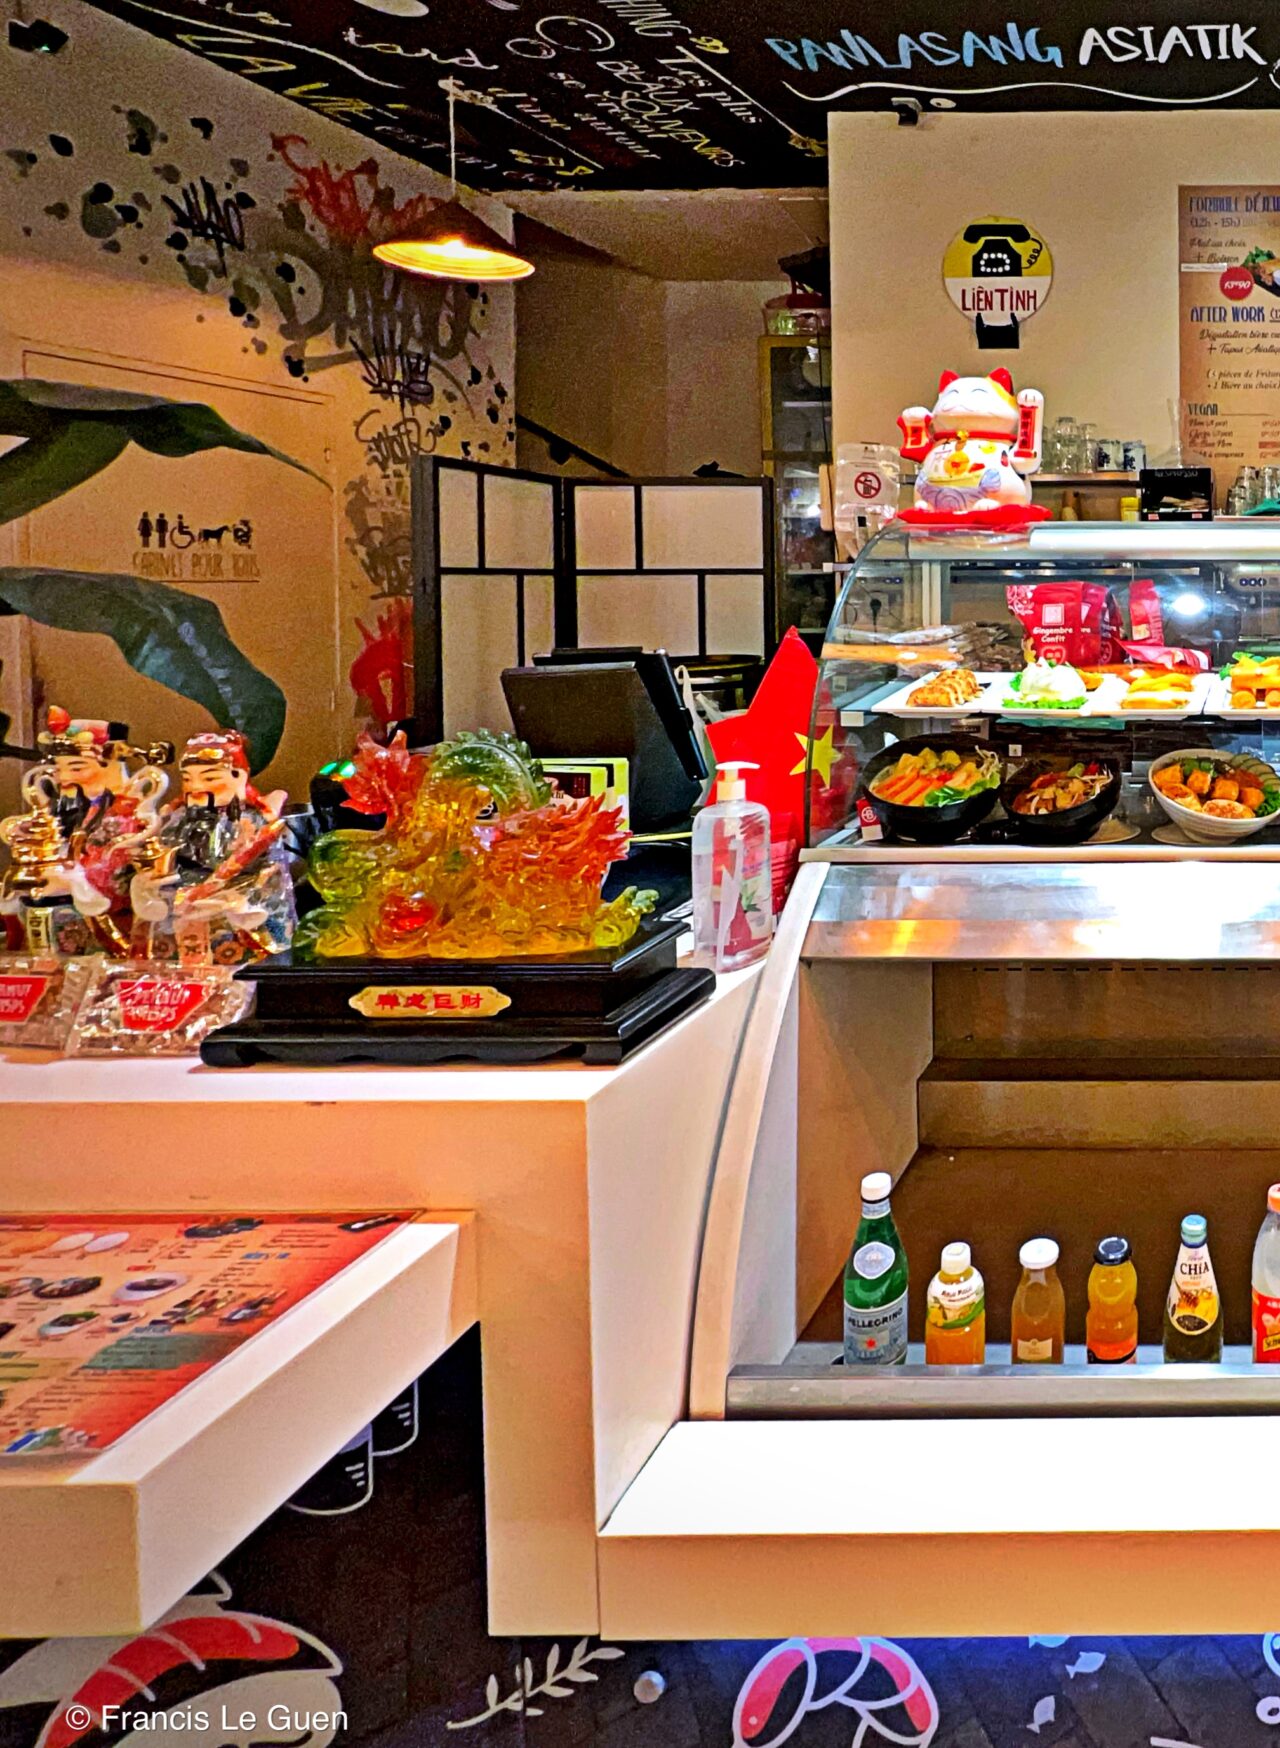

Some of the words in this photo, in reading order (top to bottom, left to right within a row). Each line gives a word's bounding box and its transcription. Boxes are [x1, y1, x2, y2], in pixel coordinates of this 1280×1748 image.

[765, 22, 1064, 72] PANLASANG
[1079, 24, 1268, 66] ASIATIK
[1190, 305, 1227, 322] AFTER
[1231, 306, 1266, 322] WORK
[1188, 403, 1218, 416] VEGAN
[1032, 627, 1074, 637] Gingembre
[1041, 635, 1066, 643] Confit
[847, 1307, 904, 1329] PELLEGRINO
